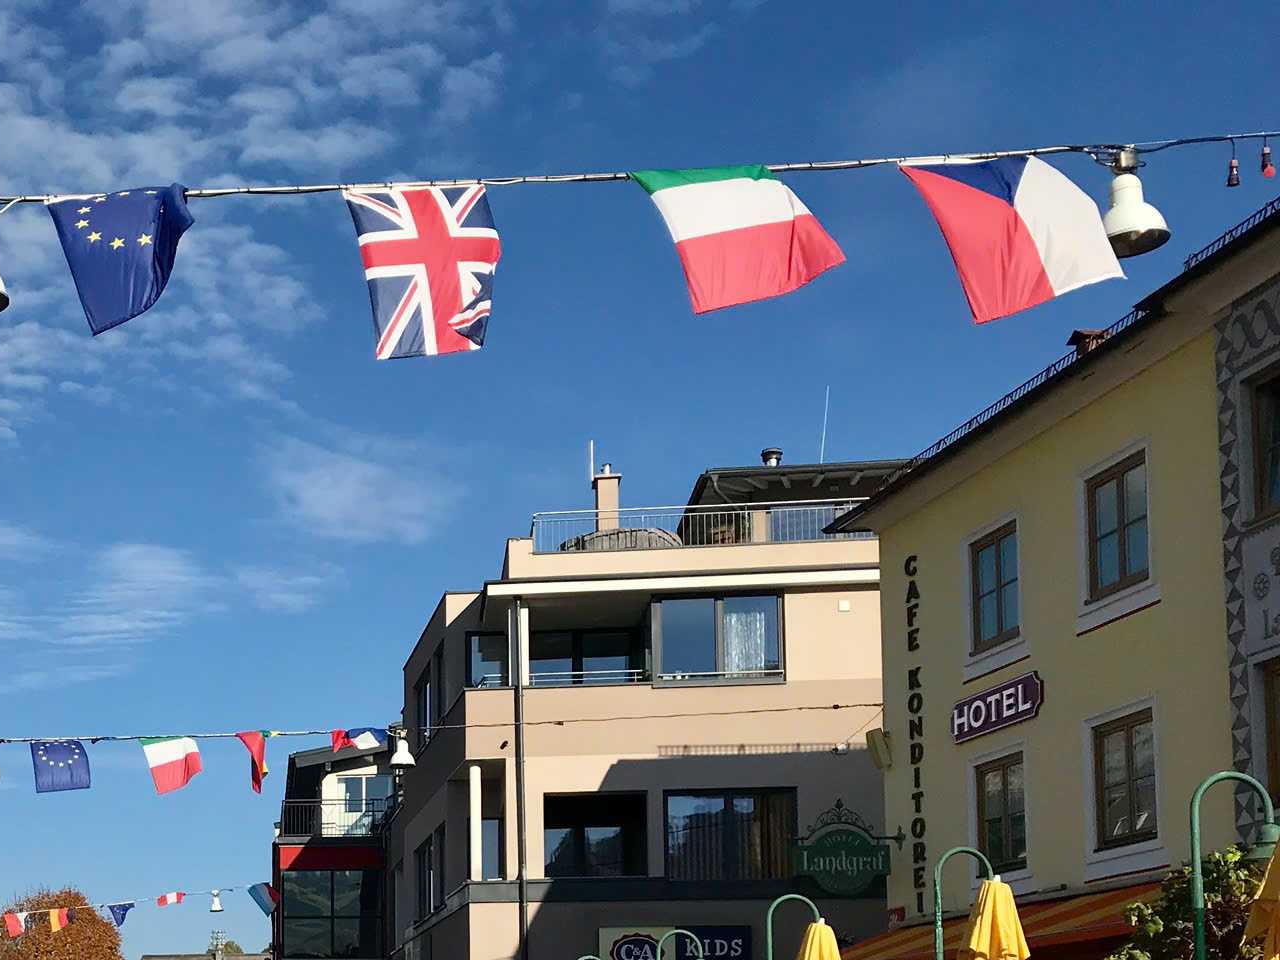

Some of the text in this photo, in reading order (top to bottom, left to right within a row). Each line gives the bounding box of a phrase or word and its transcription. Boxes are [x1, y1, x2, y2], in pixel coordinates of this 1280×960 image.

[953, 683, 1033, 737] HOTEL
[904, 555, 927, 914] CAFE KONDITOREI
[800, 850, 885, 877] Landgraf
[684, 938, 744, 957] KIDS
